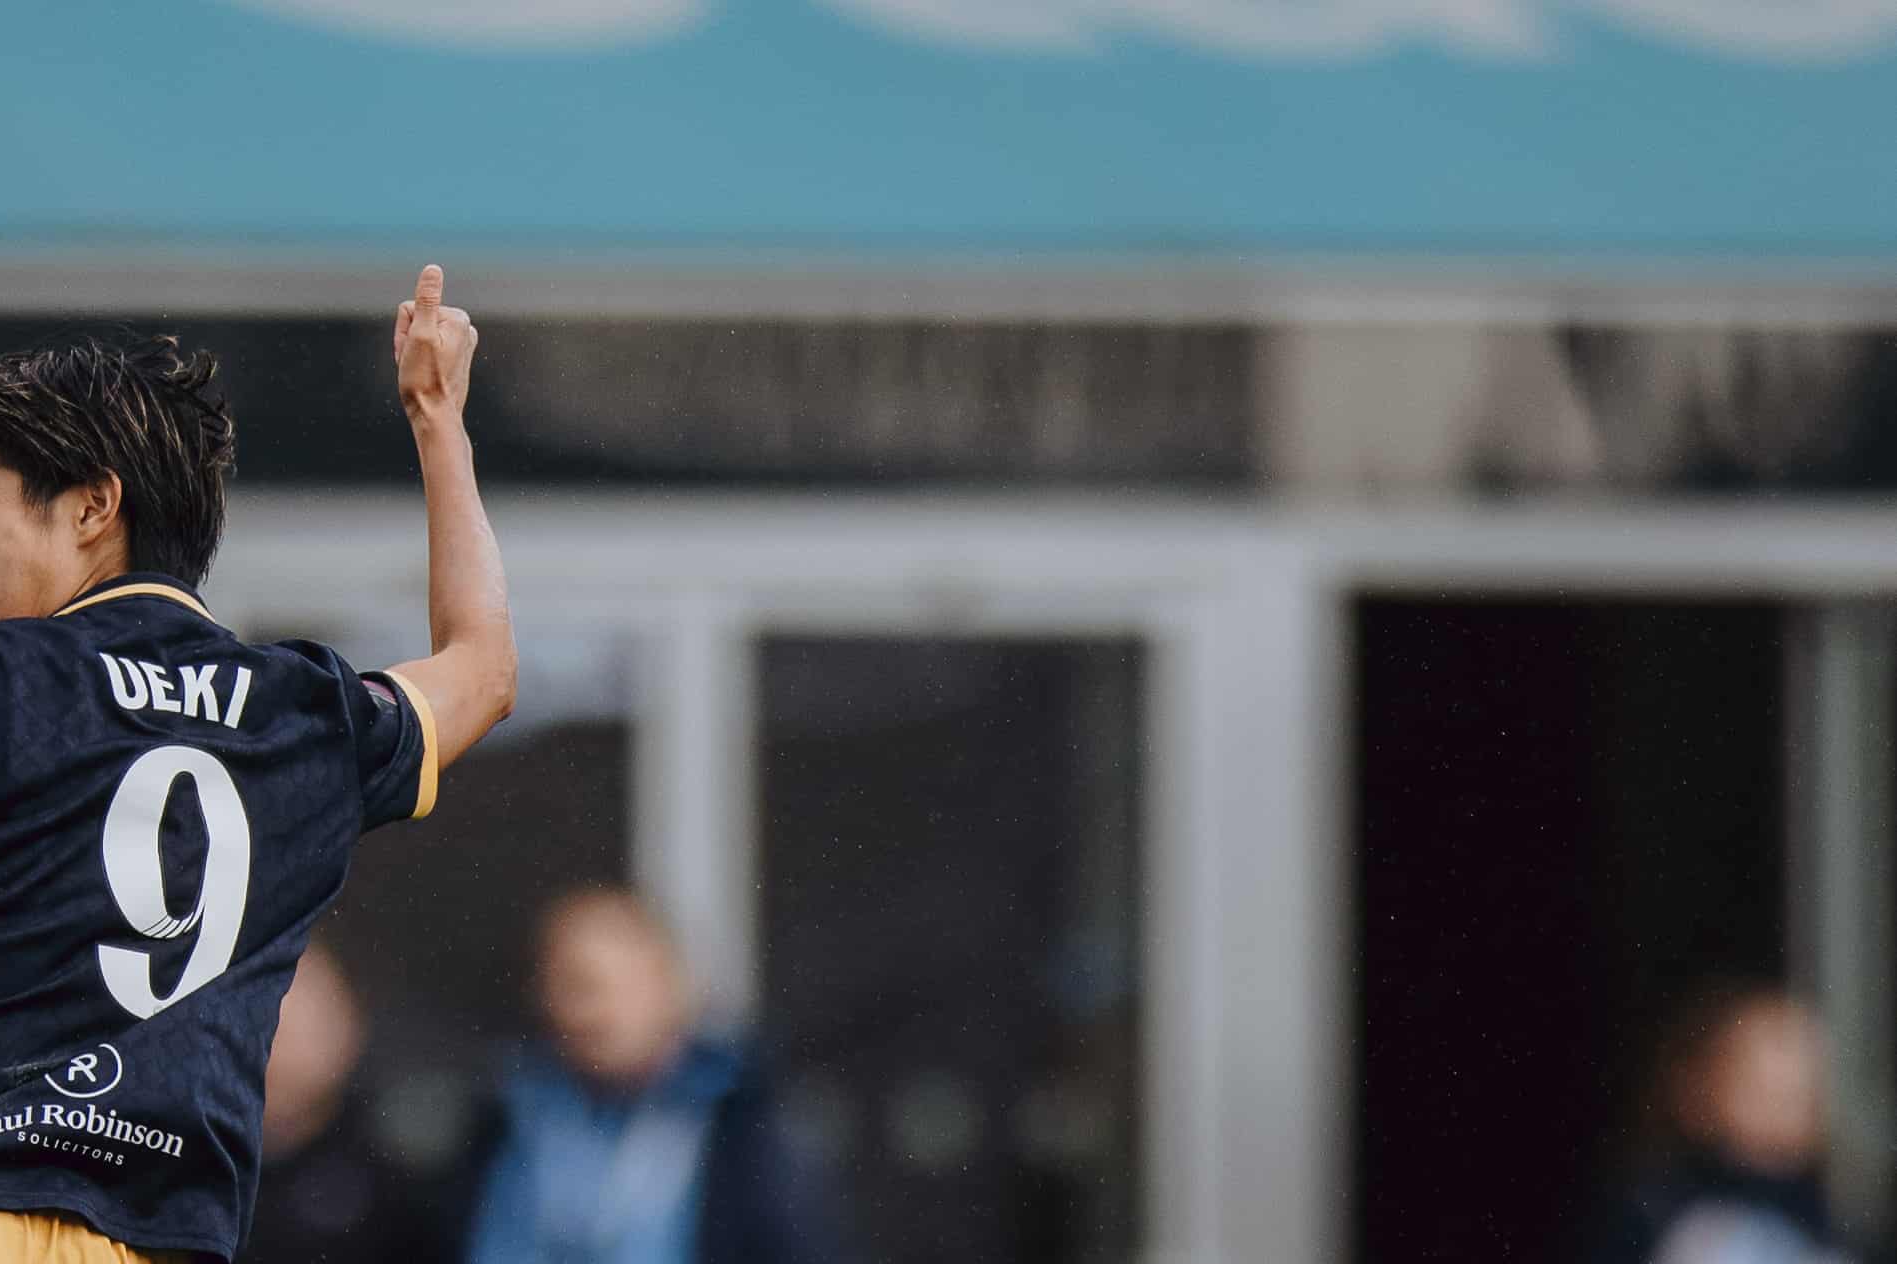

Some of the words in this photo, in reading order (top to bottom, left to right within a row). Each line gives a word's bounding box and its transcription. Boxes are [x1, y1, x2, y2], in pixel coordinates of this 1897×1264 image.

[99, 652, 252, 728] UEKI
[98, 745, 250, 1020] 9
[17, 1131, 125, 1166] SOLICITORS
[41, 1104, 184, 1158] Robinson
